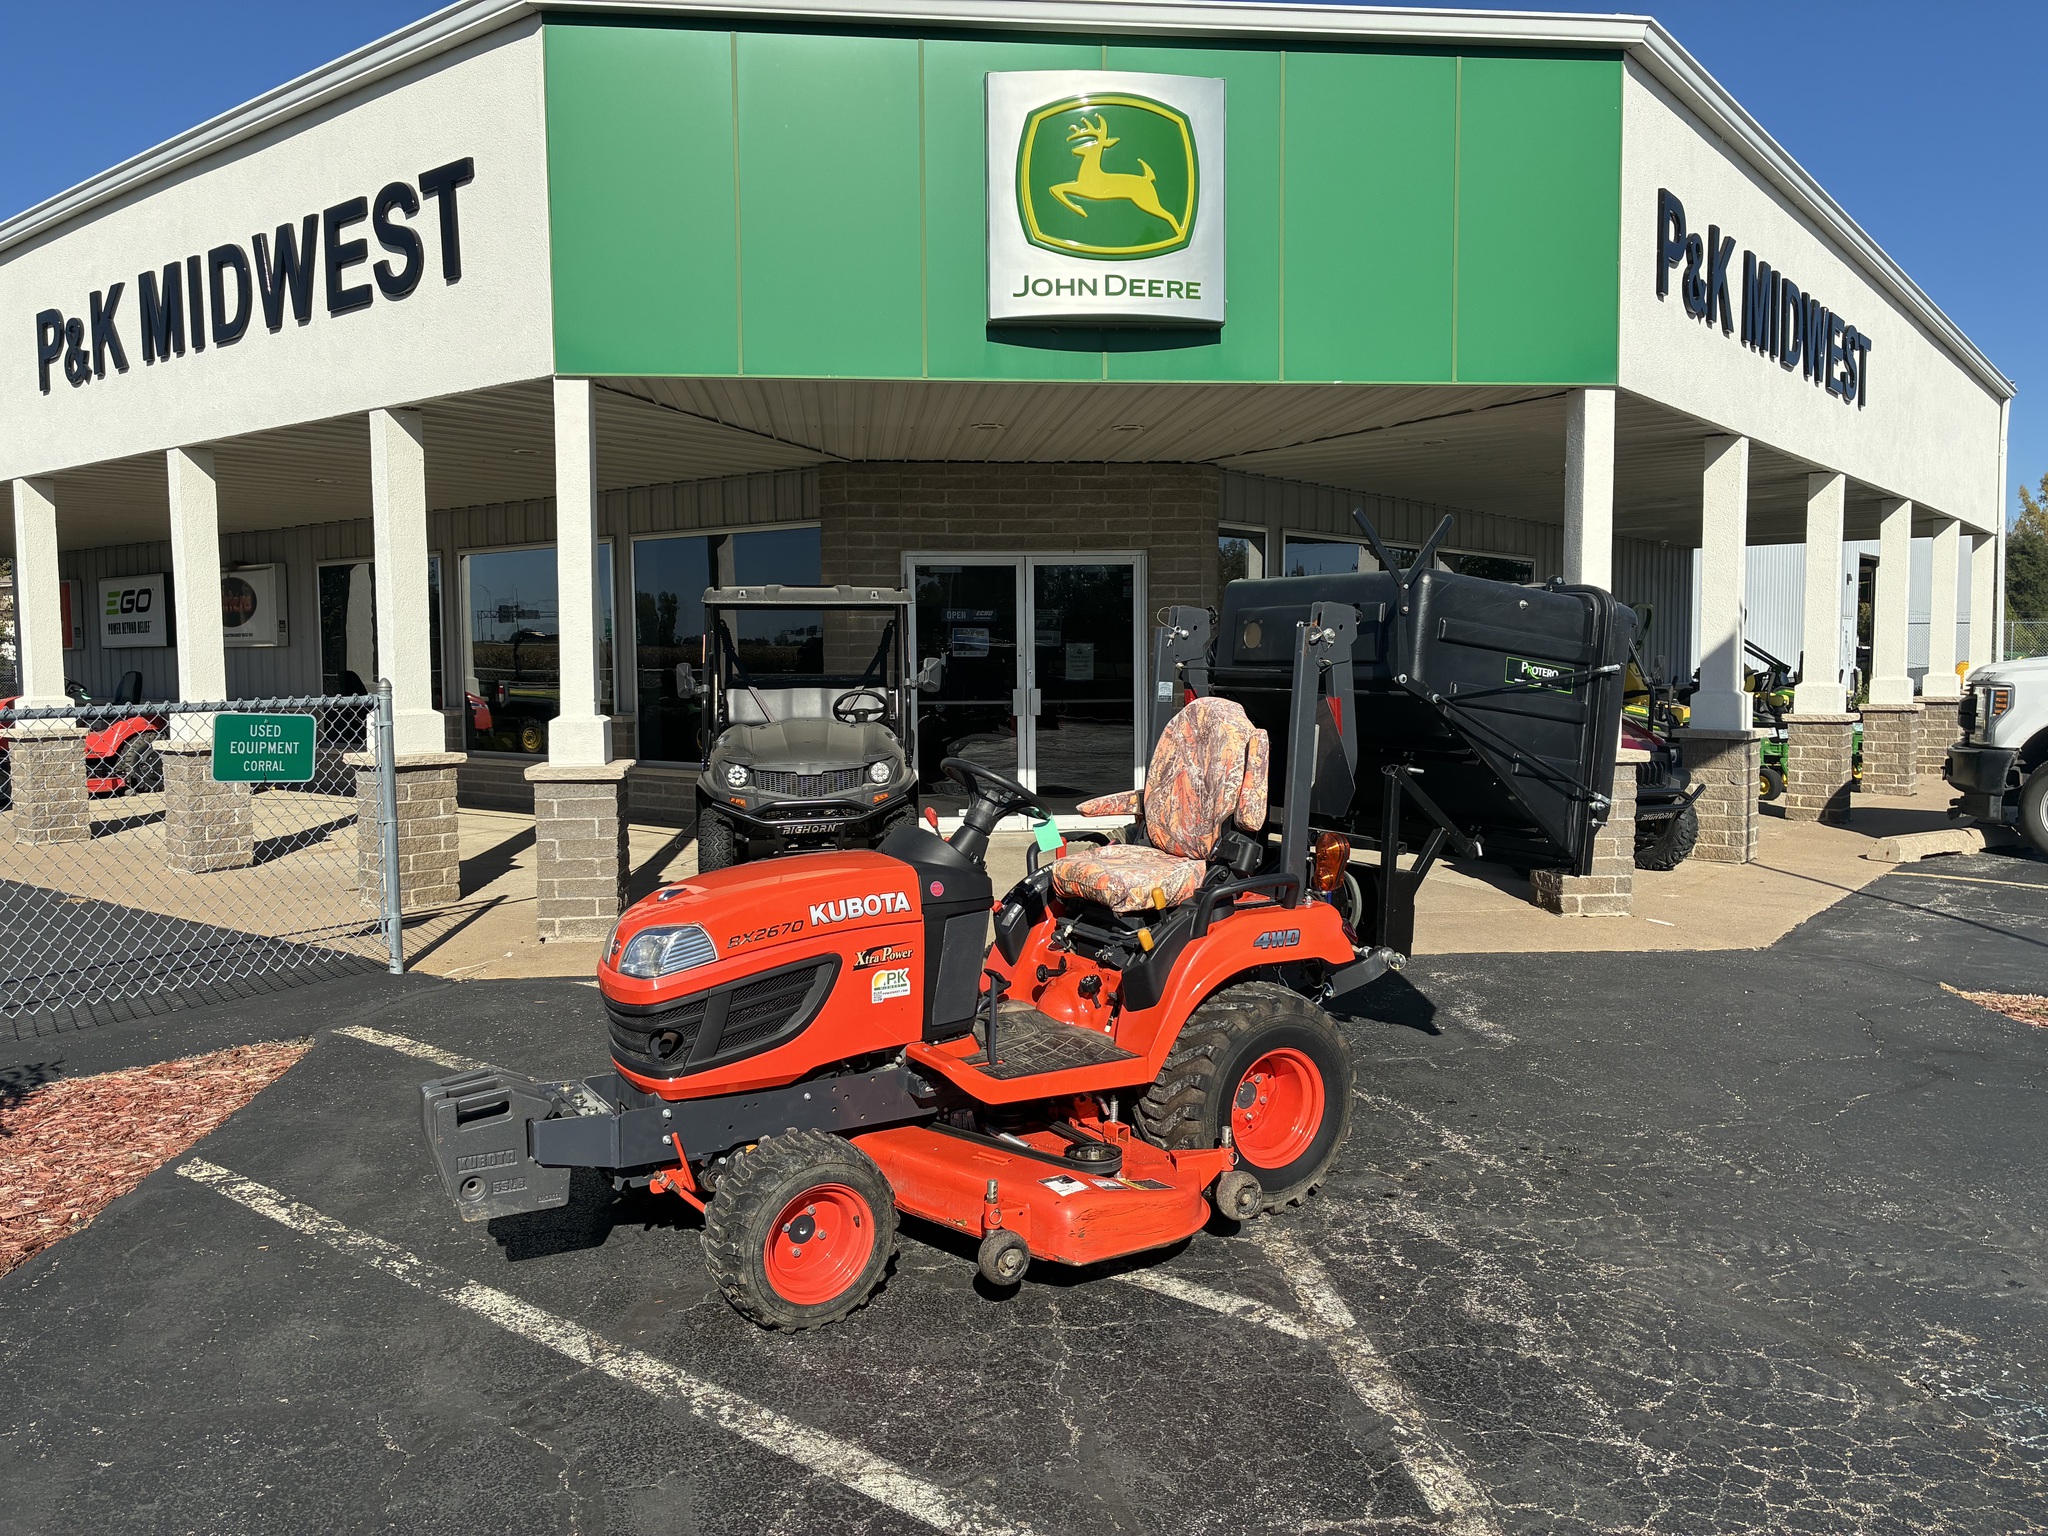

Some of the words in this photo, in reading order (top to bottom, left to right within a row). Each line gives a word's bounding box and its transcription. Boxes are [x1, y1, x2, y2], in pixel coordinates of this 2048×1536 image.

[35, 281, 129, 392] P&K
[137, 156, 475, 363] MIDWEST
[1012, 274, 1098, 298] JOHN
[1104, 274, 1202, 300] DEERE
[1655, 187, 1736, 335] P&K
[1740, 249, 1872, 408] MIDWEST
[106, 588, 152, 615] EGO
[946, 610, 967, 619] OPEN
[249, 724, 281, 737] USED
[230, 741, 299, 754] EQUIPMENT
[243, 760, 285, 771] CORRAL
[782, 824, 837, 835] BIGHORN
[808, 891, 912, 926] KUBOTA
[727, 919, 804, 949] BX2670
[1253, 928, 1301, 949] 4WD
[854, 950, 879, 966] Xtra
[881, 946, 913, 962] Power
[457, 1149, 517, 1172] KUBOTA
